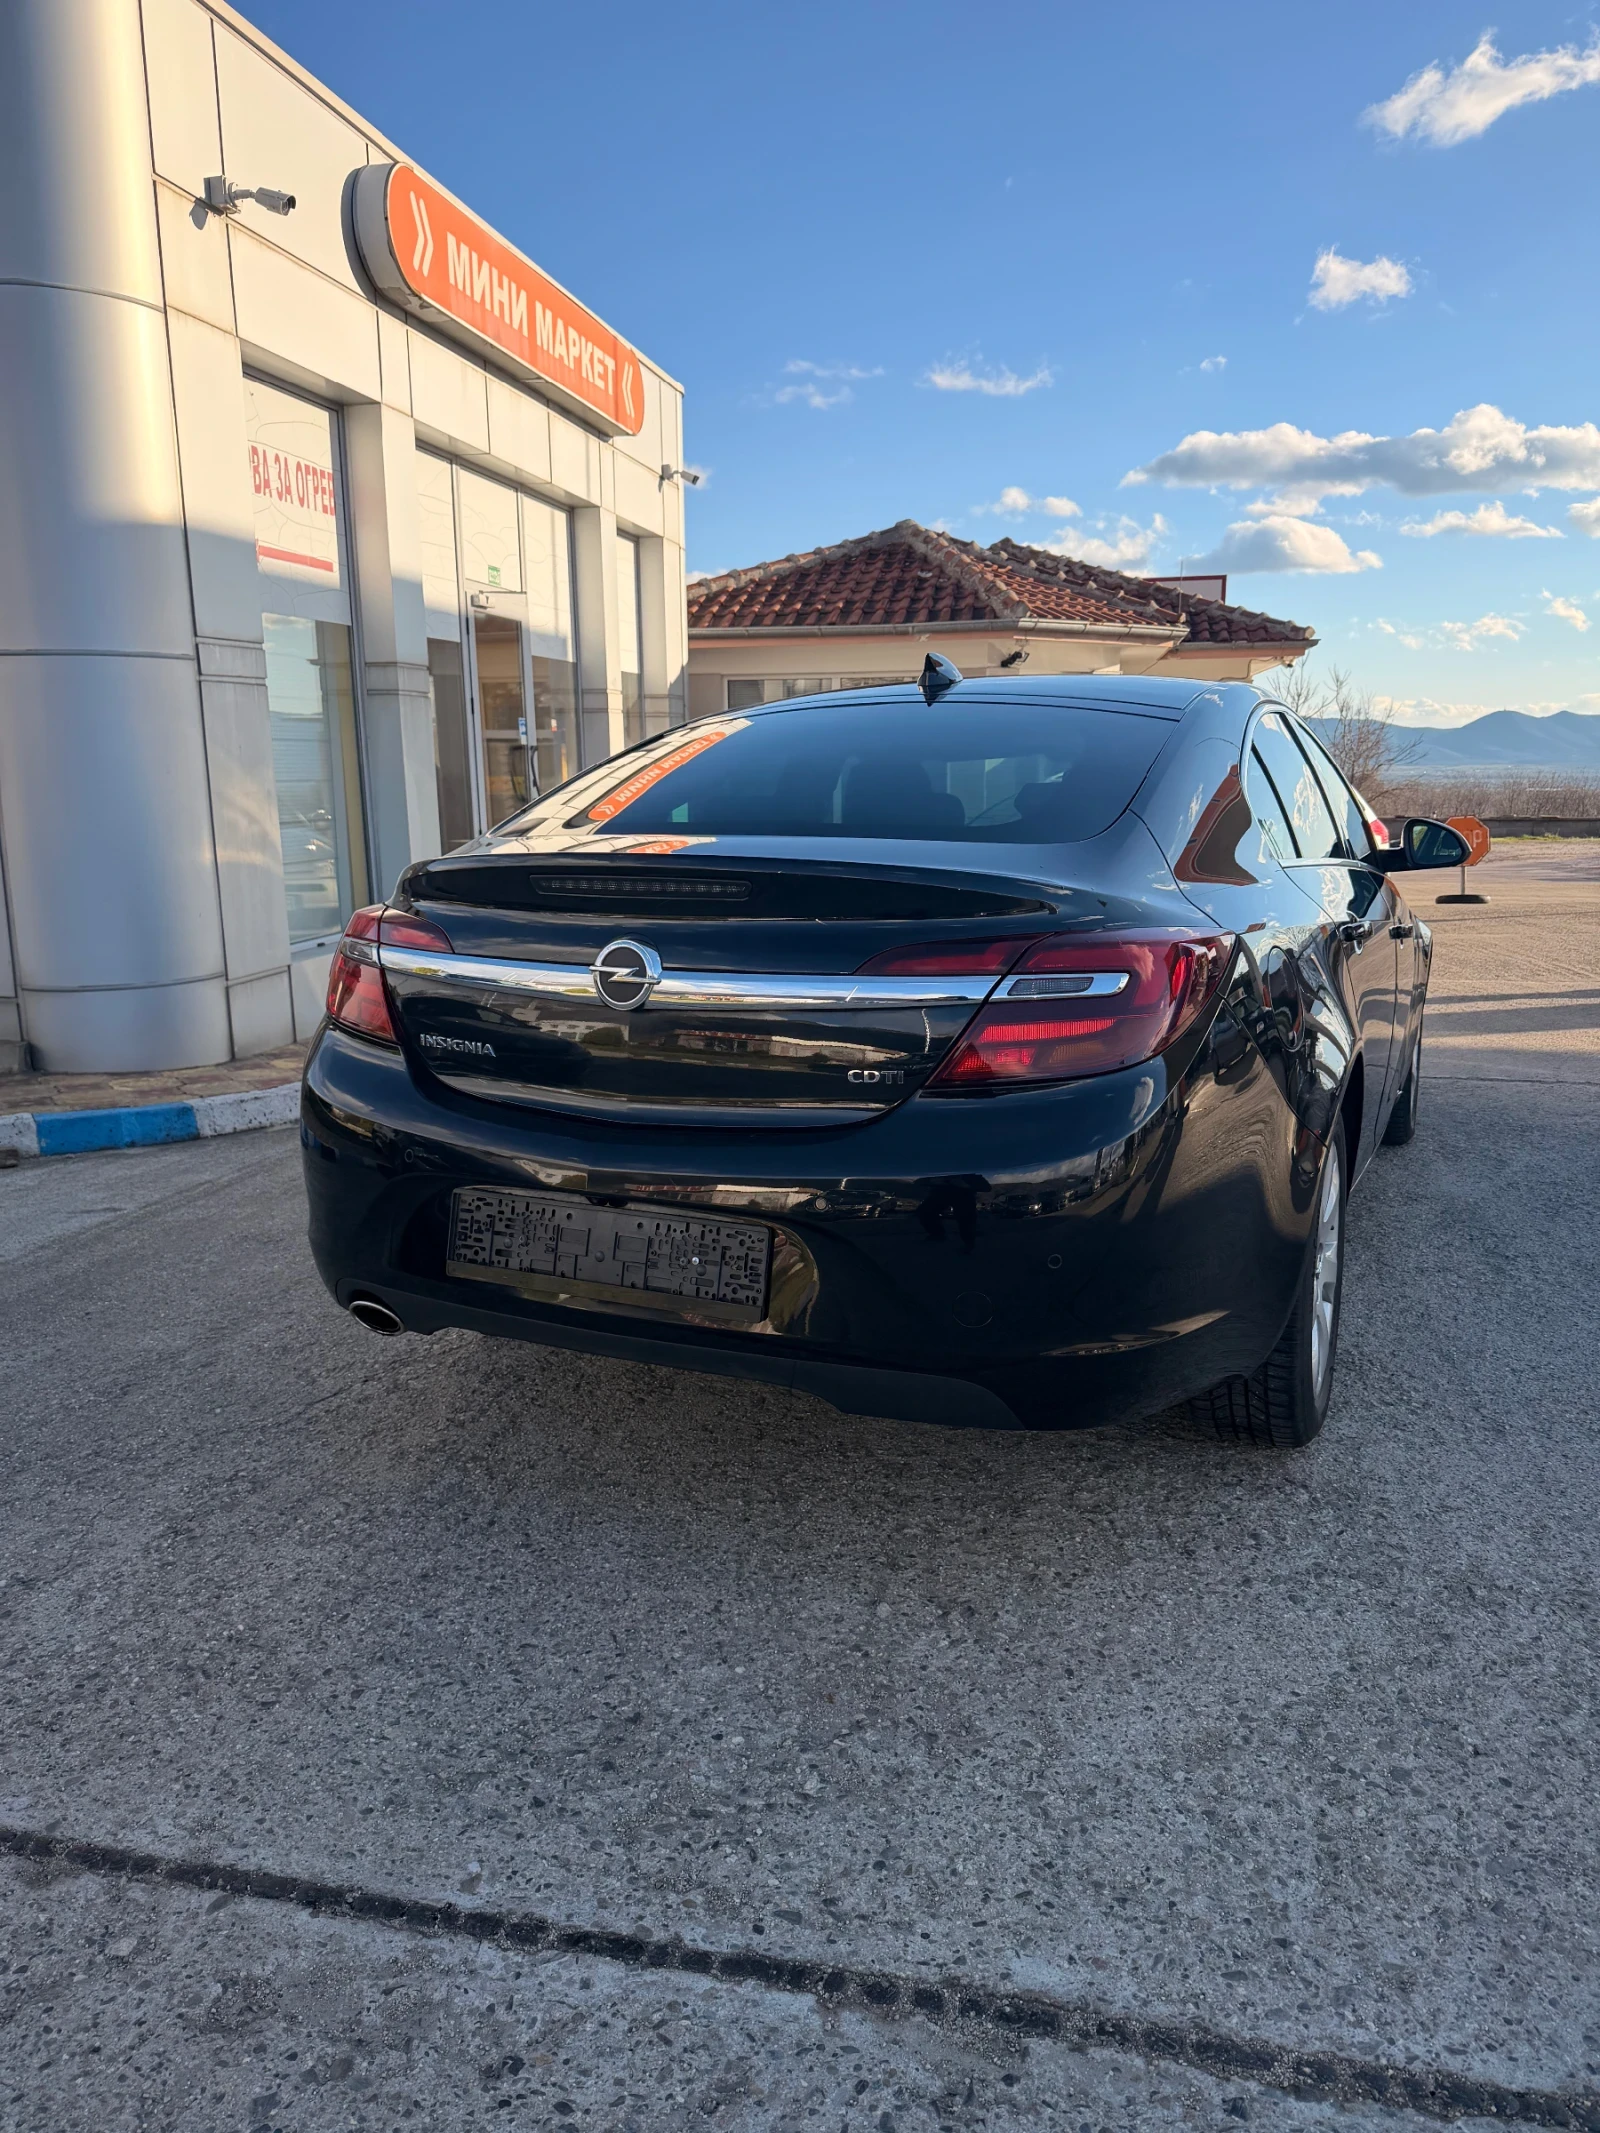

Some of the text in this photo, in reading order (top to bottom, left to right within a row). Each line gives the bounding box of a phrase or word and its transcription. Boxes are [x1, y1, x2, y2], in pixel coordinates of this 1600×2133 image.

[446, 231, 616, 396] МИНИ МАРКЕТ
[248, 444, 273, 498] ВА
[274, 452, 294, 505] ЗА
[420, 1033, 497, 1058] INSIGNIA
[847, 1069, 905, 1085] CDTI
